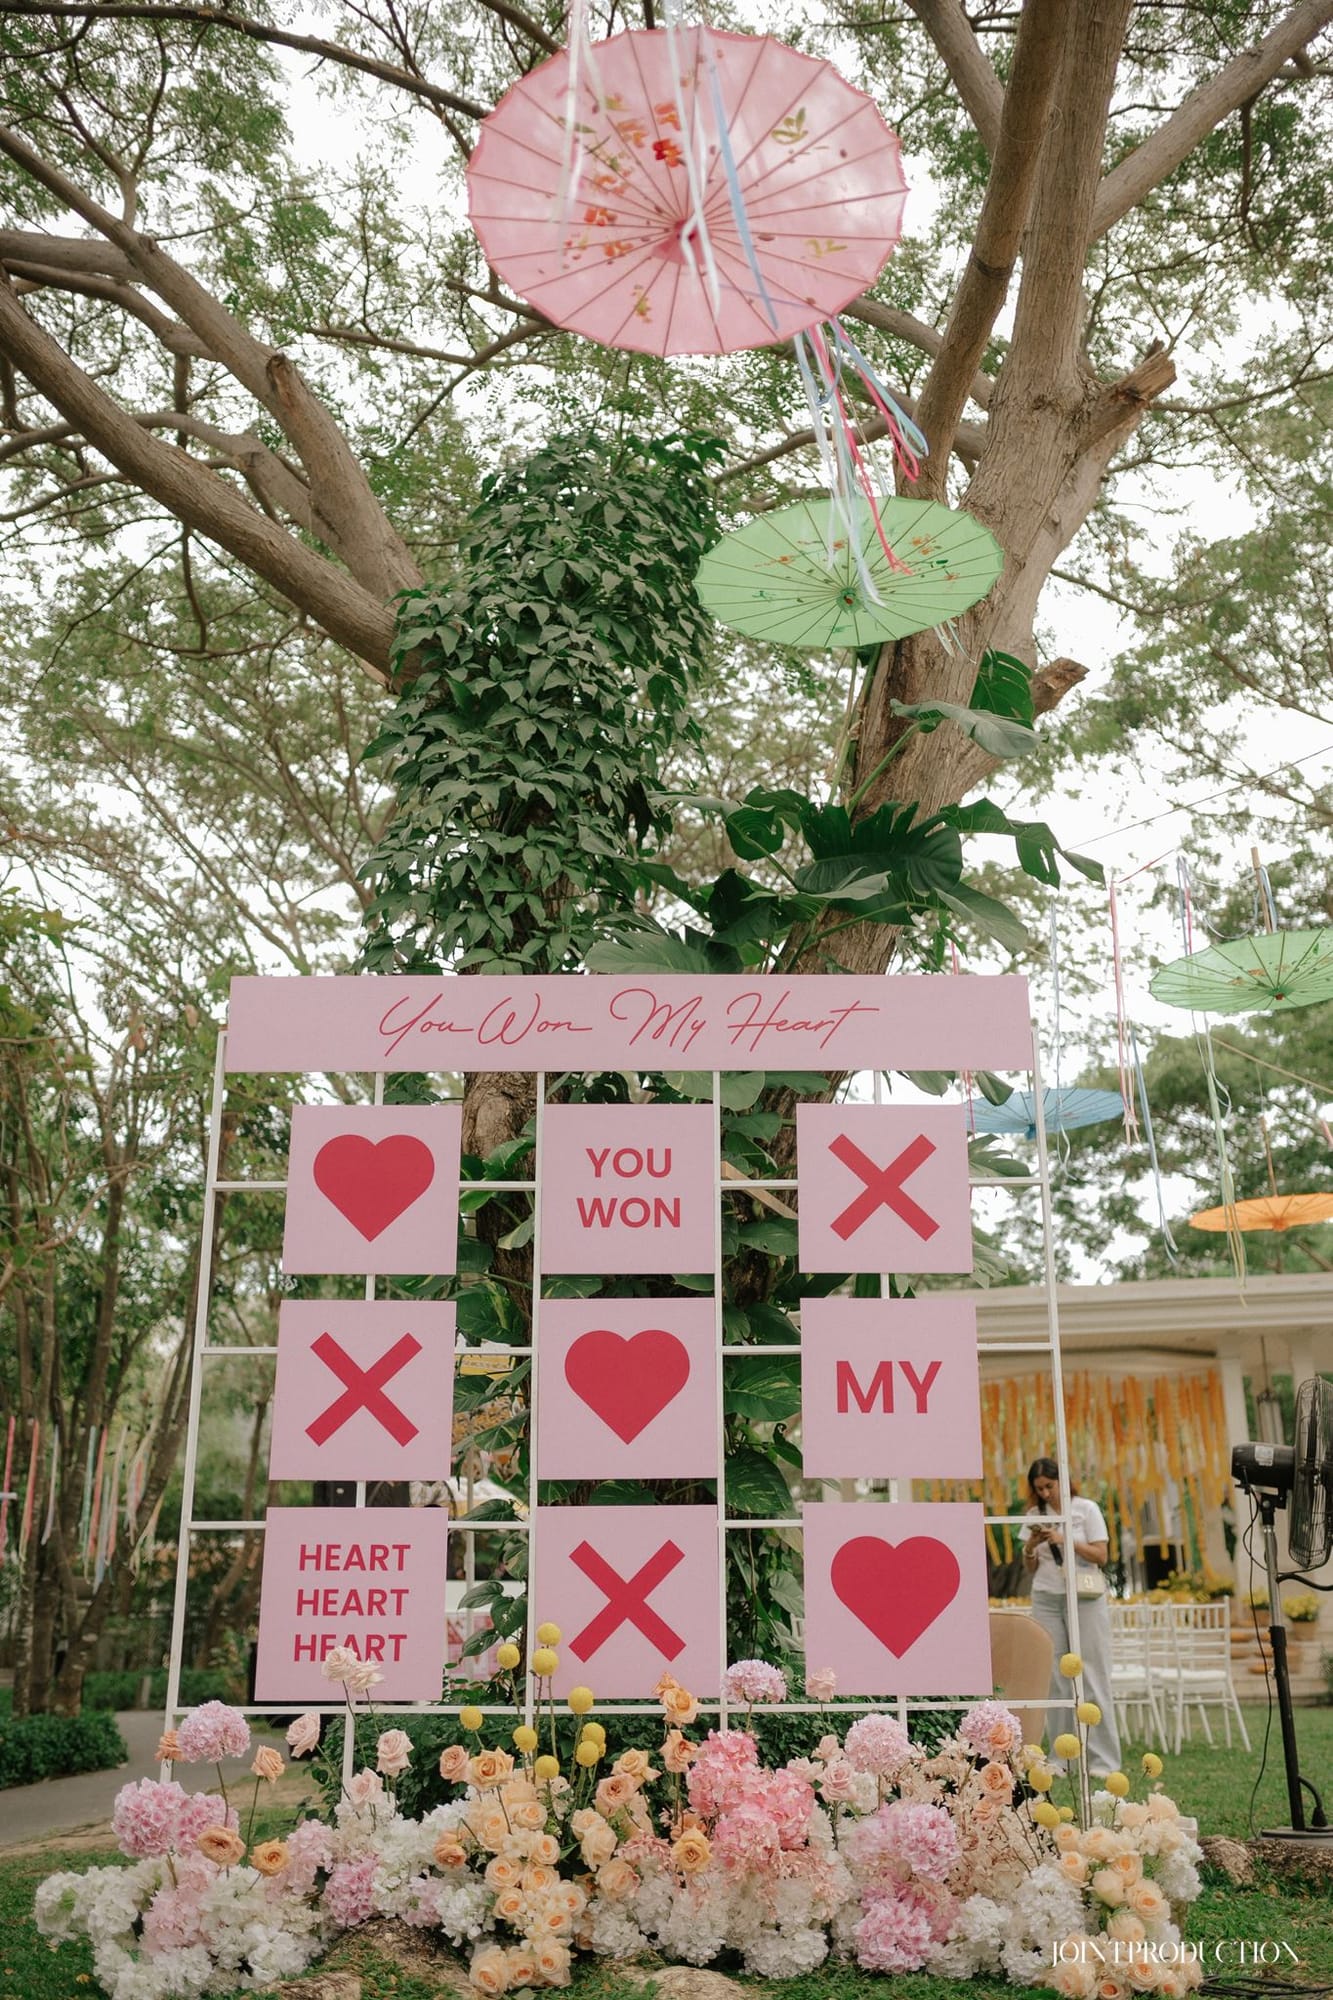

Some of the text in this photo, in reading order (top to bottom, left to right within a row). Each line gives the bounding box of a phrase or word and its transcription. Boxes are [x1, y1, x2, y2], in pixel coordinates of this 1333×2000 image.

[380, 988, 880, 1057] You Won My Heart
[586, 1147, 672, 1179] YOU
[577, 1197, 681, 1229] WON
[836, 1360, 943, 1415] MY
[299, 1543, 412, 1572] HEART
[296, 1588, 410, 1617] HEART
